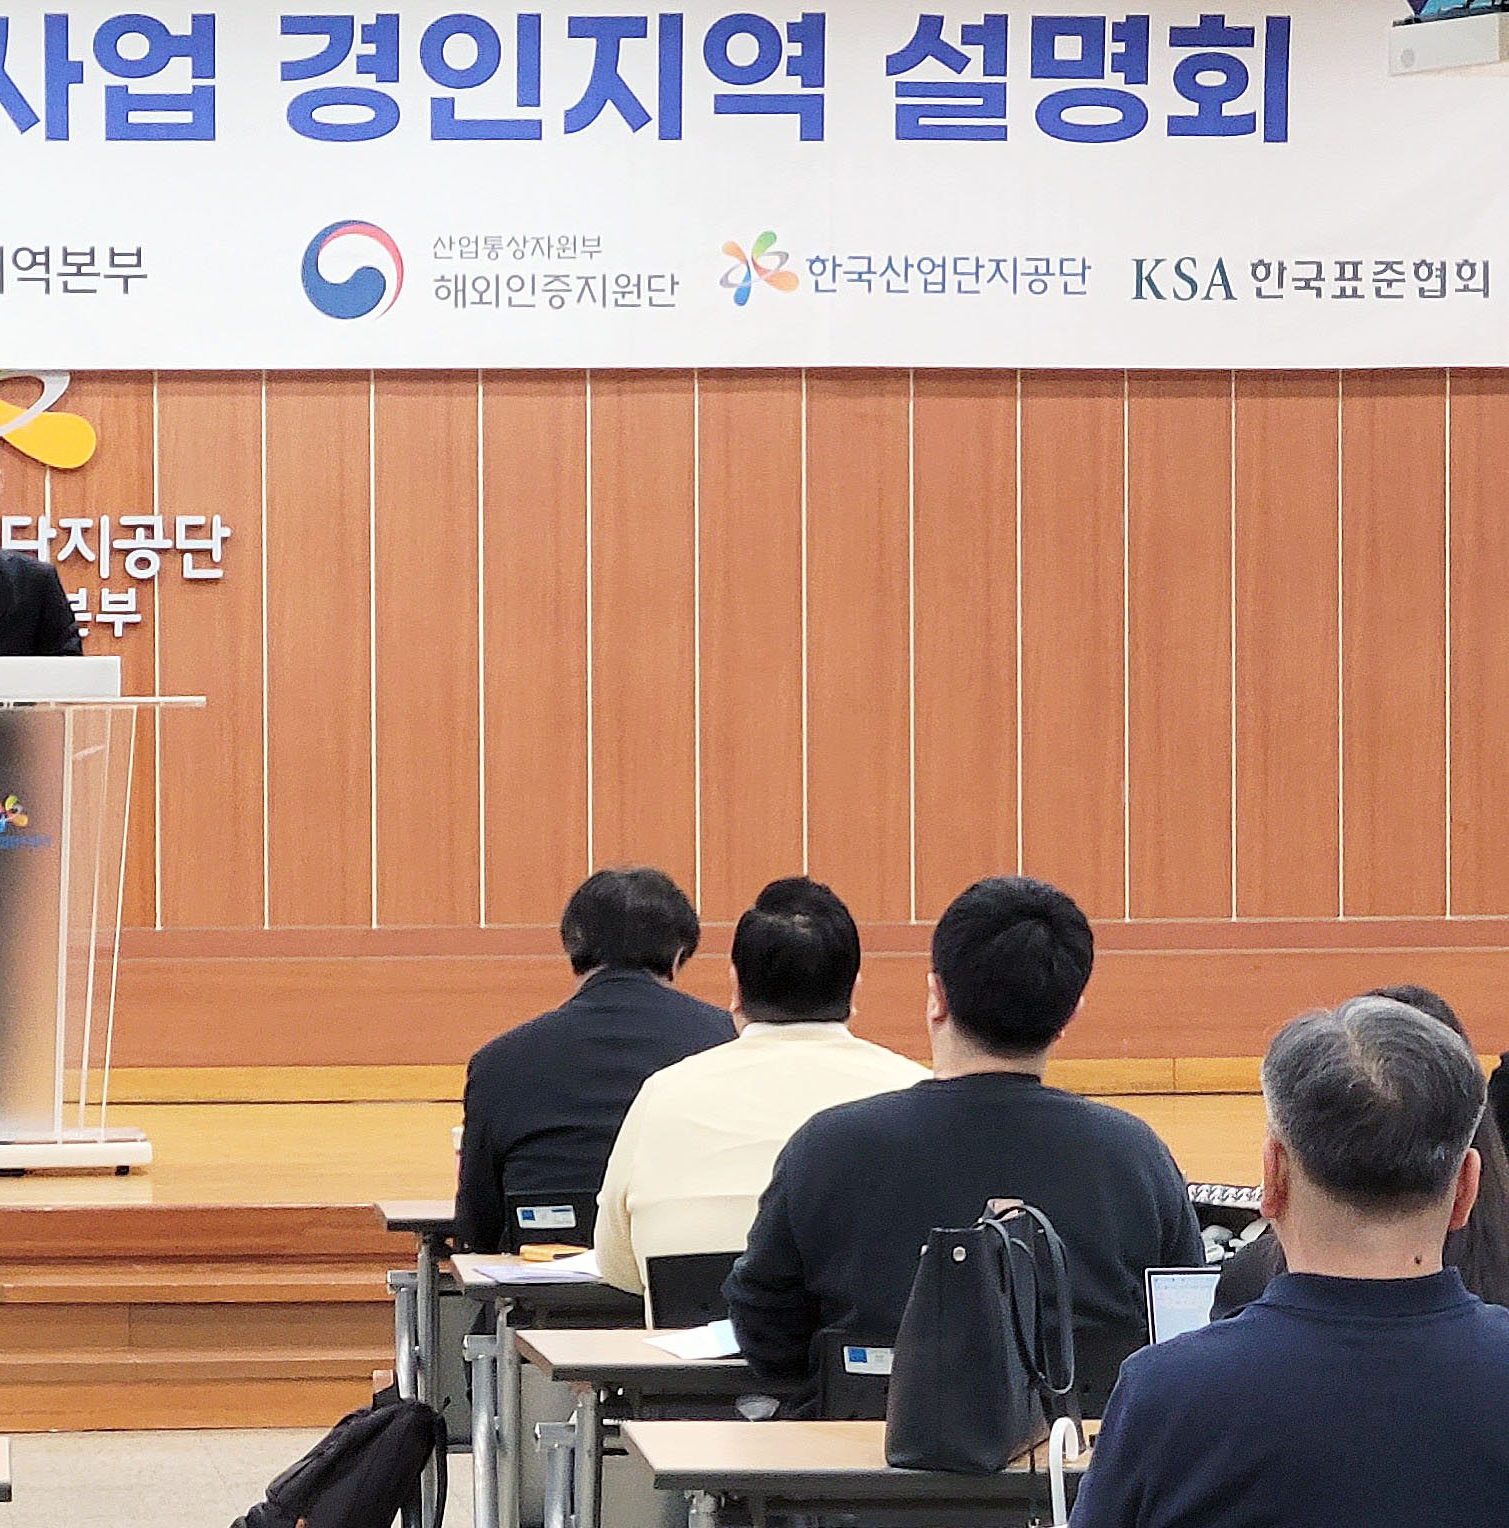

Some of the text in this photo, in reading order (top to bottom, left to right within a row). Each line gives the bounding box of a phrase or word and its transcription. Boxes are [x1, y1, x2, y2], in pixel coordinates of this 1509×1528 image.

[279, 13, 826, 143] 경인지역
[885, 13, 1291, 144] 설명회
[432, 234, 603, 261] 산업통상자원부
[433, 272, 681, 311] 해외인증지원단
[805, 254, 1093, 297] 한국산업단지공단
[1130, 256, 1491, 302] KSA 한국표준협회
